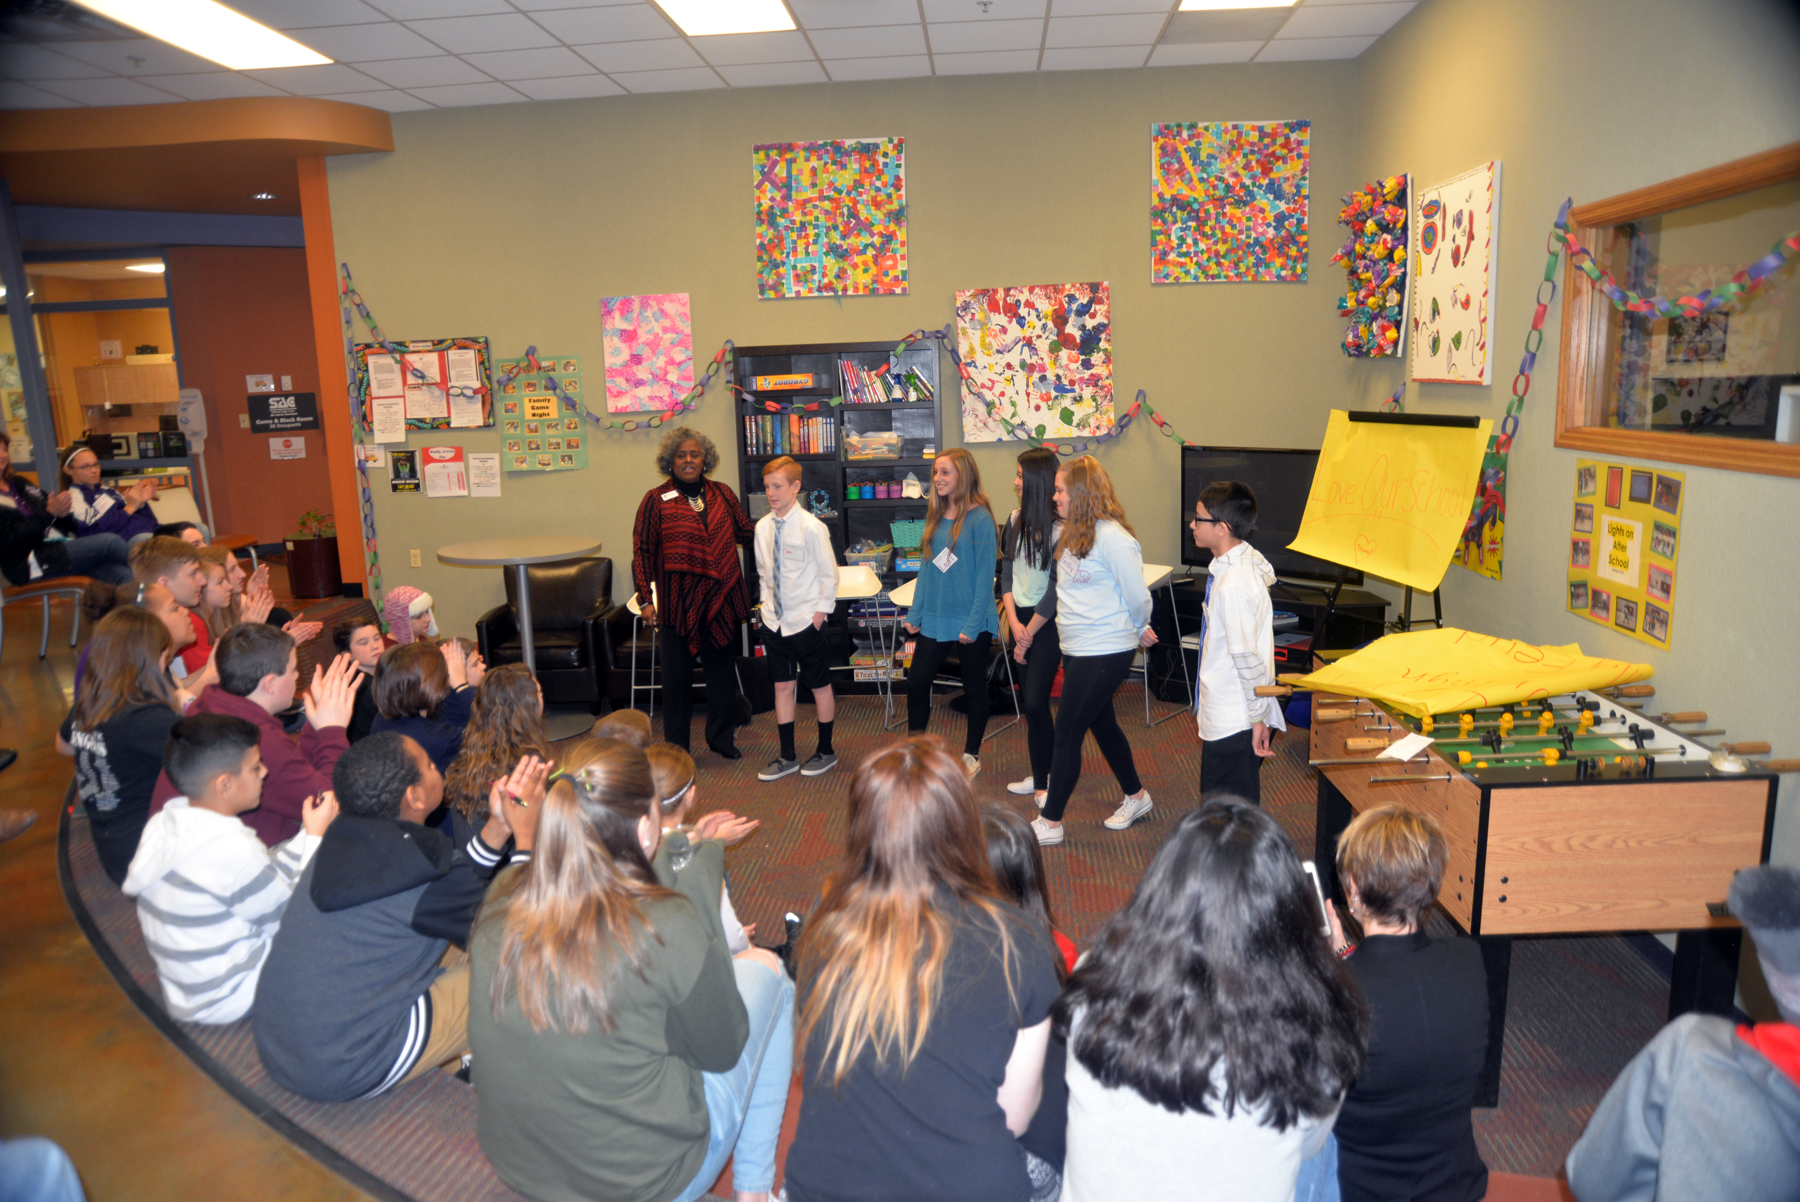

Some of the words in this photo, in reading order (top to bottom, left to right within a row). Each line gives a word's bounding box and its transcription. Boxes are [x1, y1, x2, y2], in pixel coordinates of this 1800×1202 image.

[774, 378, 809, 386] GYROBOT
[268, 396, 296, 409] SAC
[1311, 447, 1357, 504] Love
[1401, 469, 1469, 518] School
[1607, 523, 1625, 537] Lights
[1625, 530, 1634, 539] on
[1612, 540, 1627, 553] After
[1608, 554, 1630, 569] School
